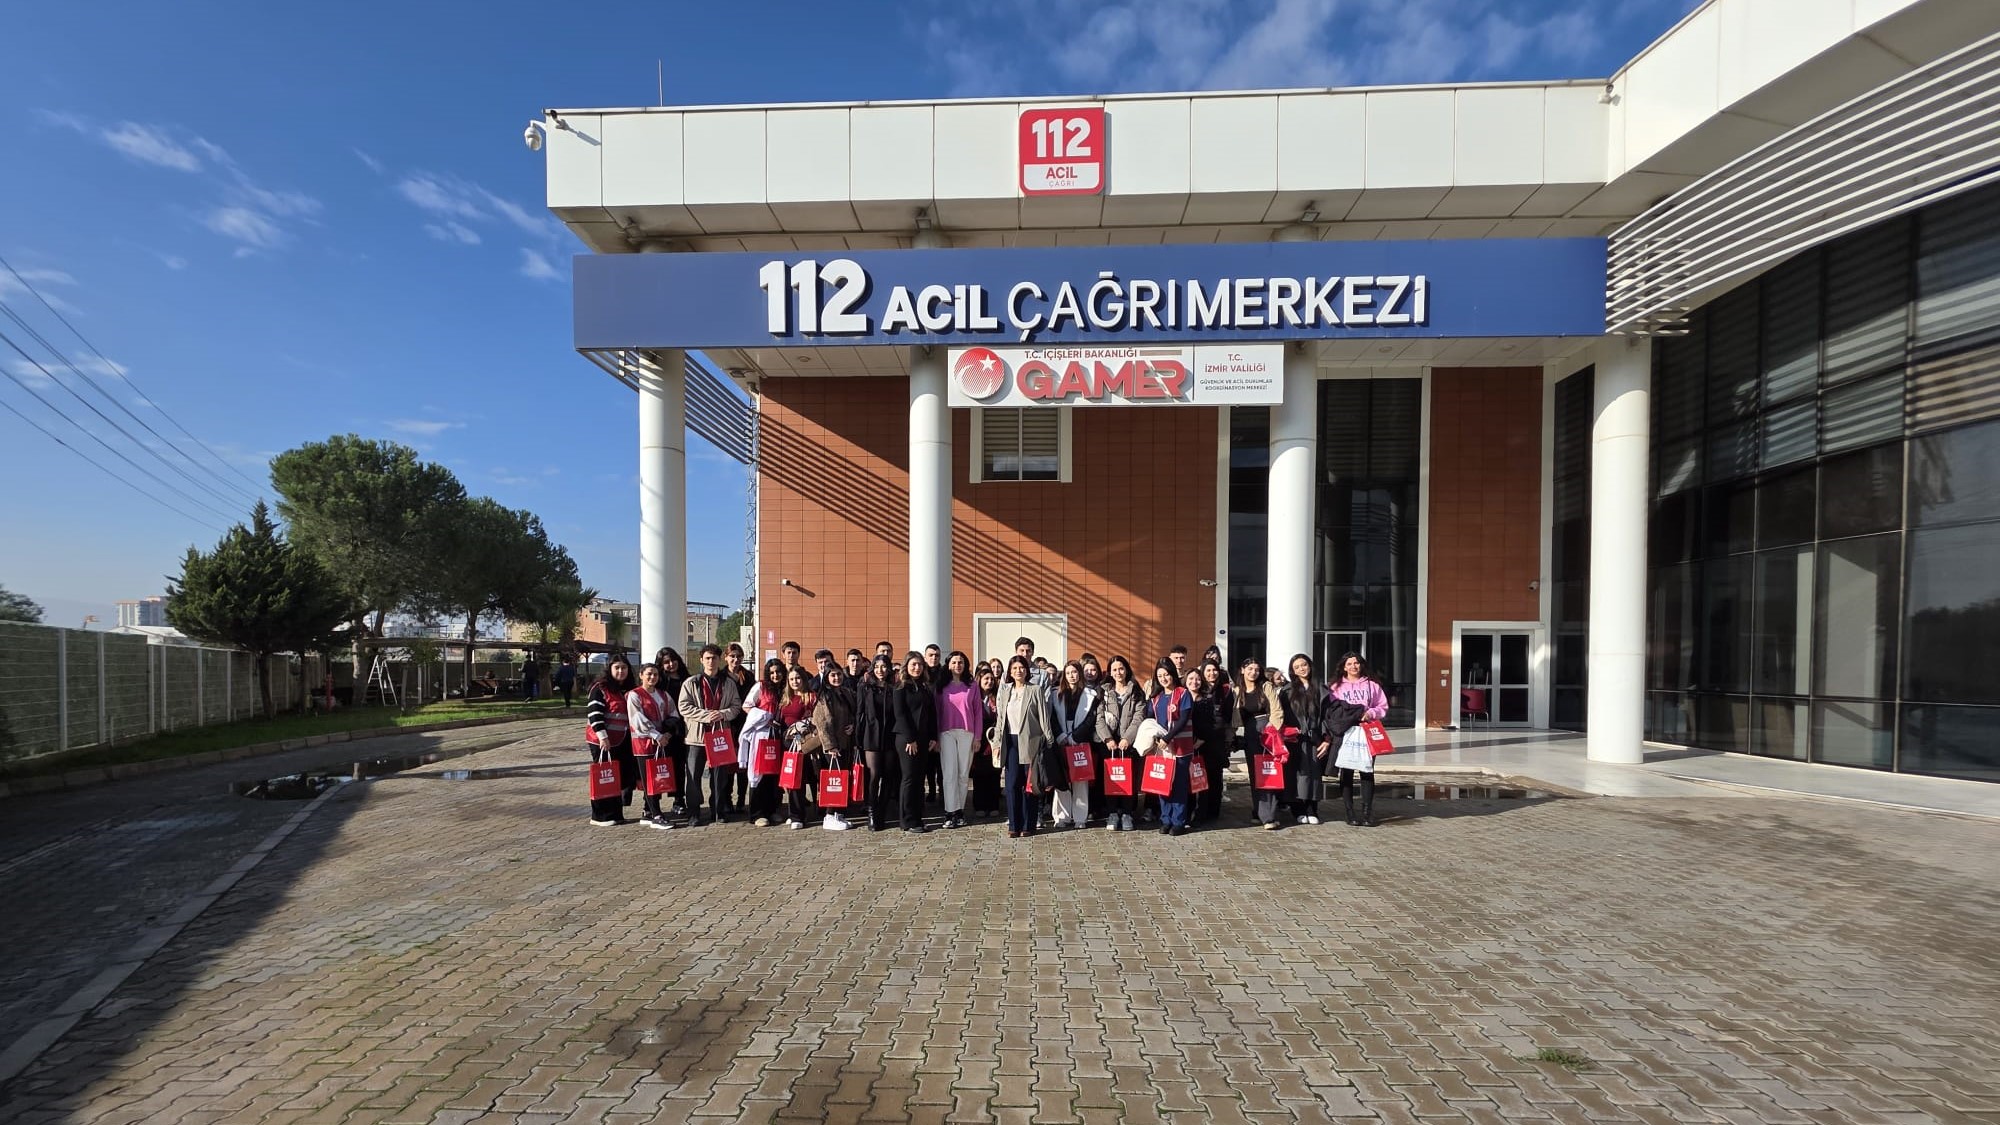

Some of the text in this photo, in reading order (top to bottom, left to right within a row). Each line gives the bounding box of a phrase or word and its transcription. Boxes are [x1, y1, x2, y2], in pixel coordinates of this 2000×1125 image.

[1032, 117, 1091, 157] 112
[759, 258, 867, 333] 112
[1007, 271, 1176, 342] ÇAĞRI
[1024, 347, 1137, 361] T.C. İÇİŞLERİ BAKANLIĞI
[1228, 353, 1243, 361] T.C.
[1205, 363, 1266, 373] İZMİR VALİLİĞİ
[1016, 360, 1186, 399] GAMER
[713, 736, 726, 746] 112
[766, 746, 776, 754] 112
[1074, 752, 1086, 760] 112
[657, 764, 668, 773] 112
[1112, 766, 1124, 774] 112
[1153, 763, 1165, 772] 112
[600, 769, 613, 778] 112
[829, 777, 841, 785] 112
